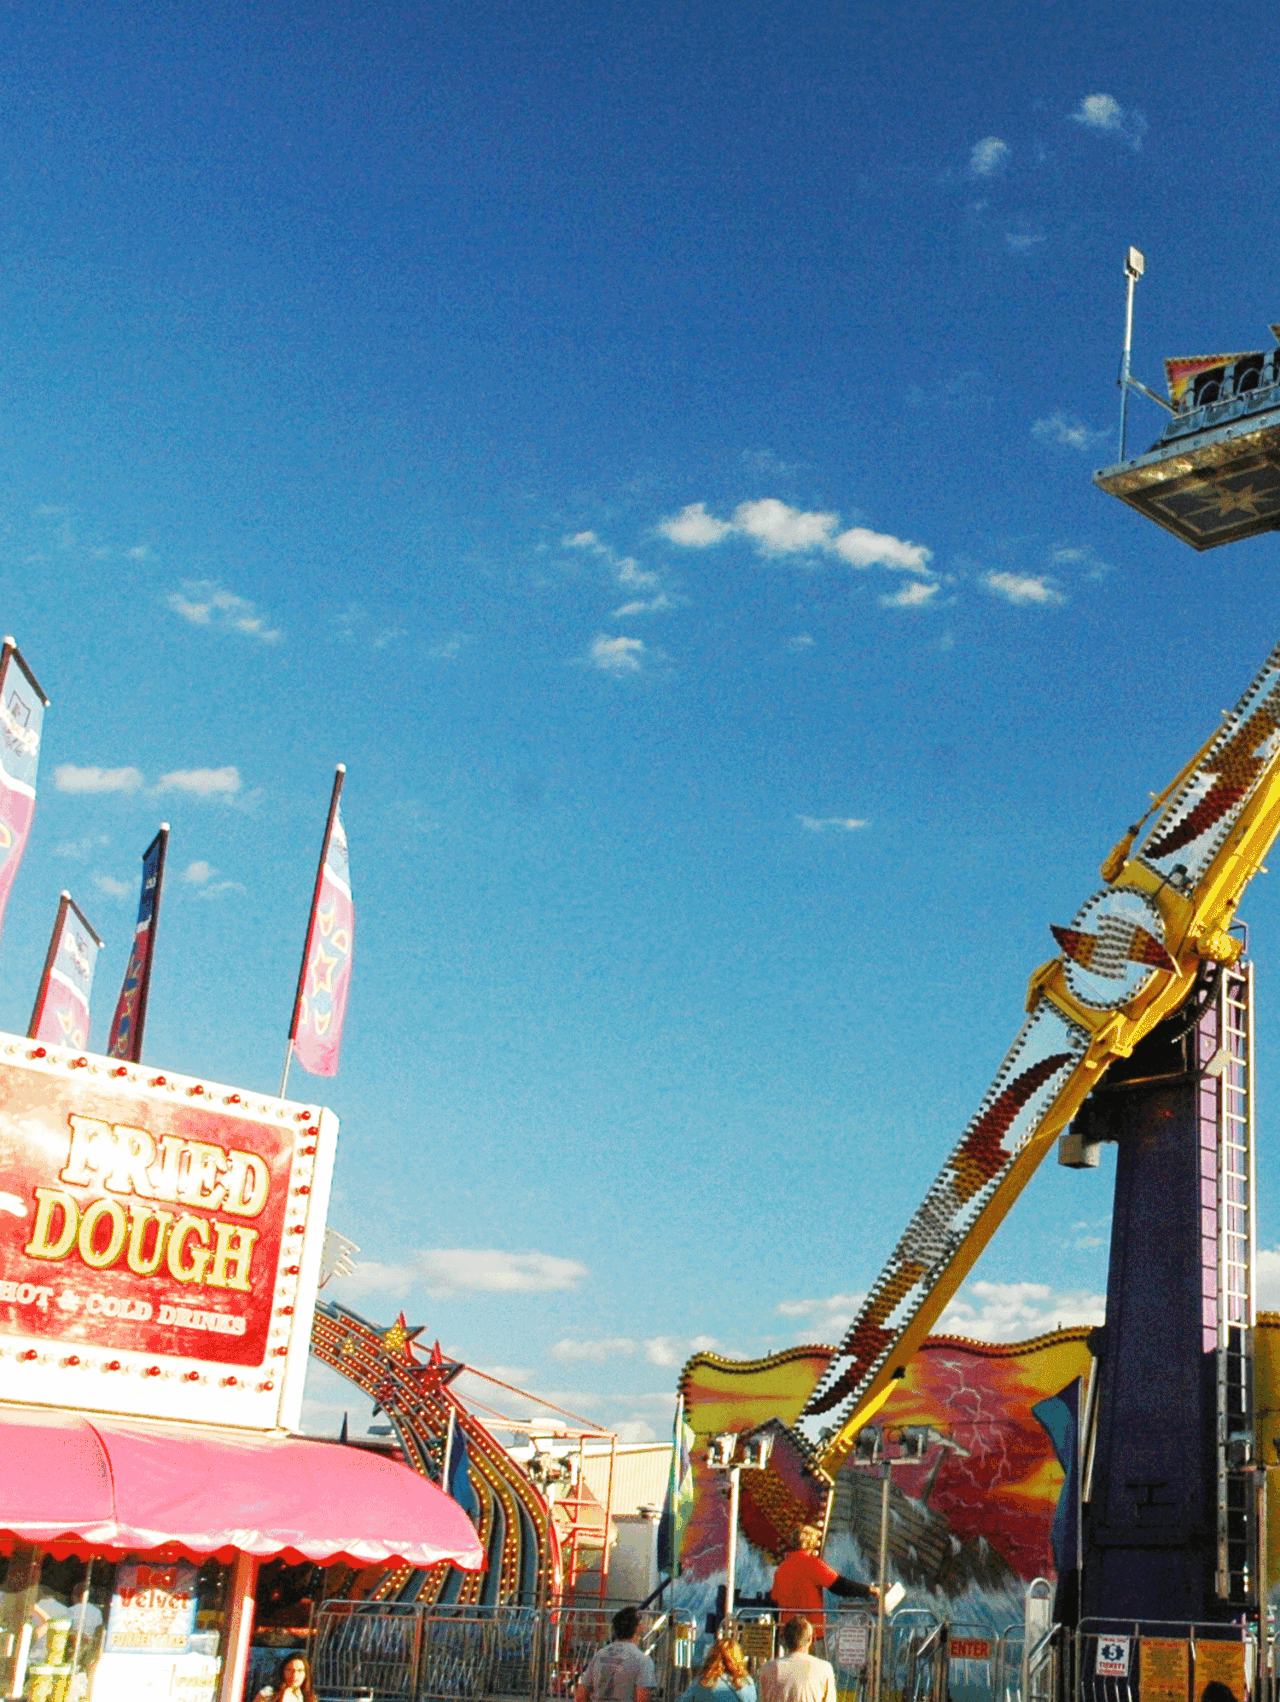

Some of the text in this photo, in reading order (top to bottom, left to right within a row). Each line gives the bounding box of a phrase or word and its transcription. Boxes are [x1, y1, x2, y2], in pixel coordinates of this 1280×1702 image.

[59, 1113, 270, 1219] FRIED
[23, 1187, 259, 1292] DOUGH
[0, 1281, 247, 1336] HOT & COLD DRINKS
[136, 1565, 177, 1588] Red
[120, 1586, 190, 1610] Velvet
[951, 1640, 988, 1657] ENTER
[1108, 1645, 1118, 1660] 5
